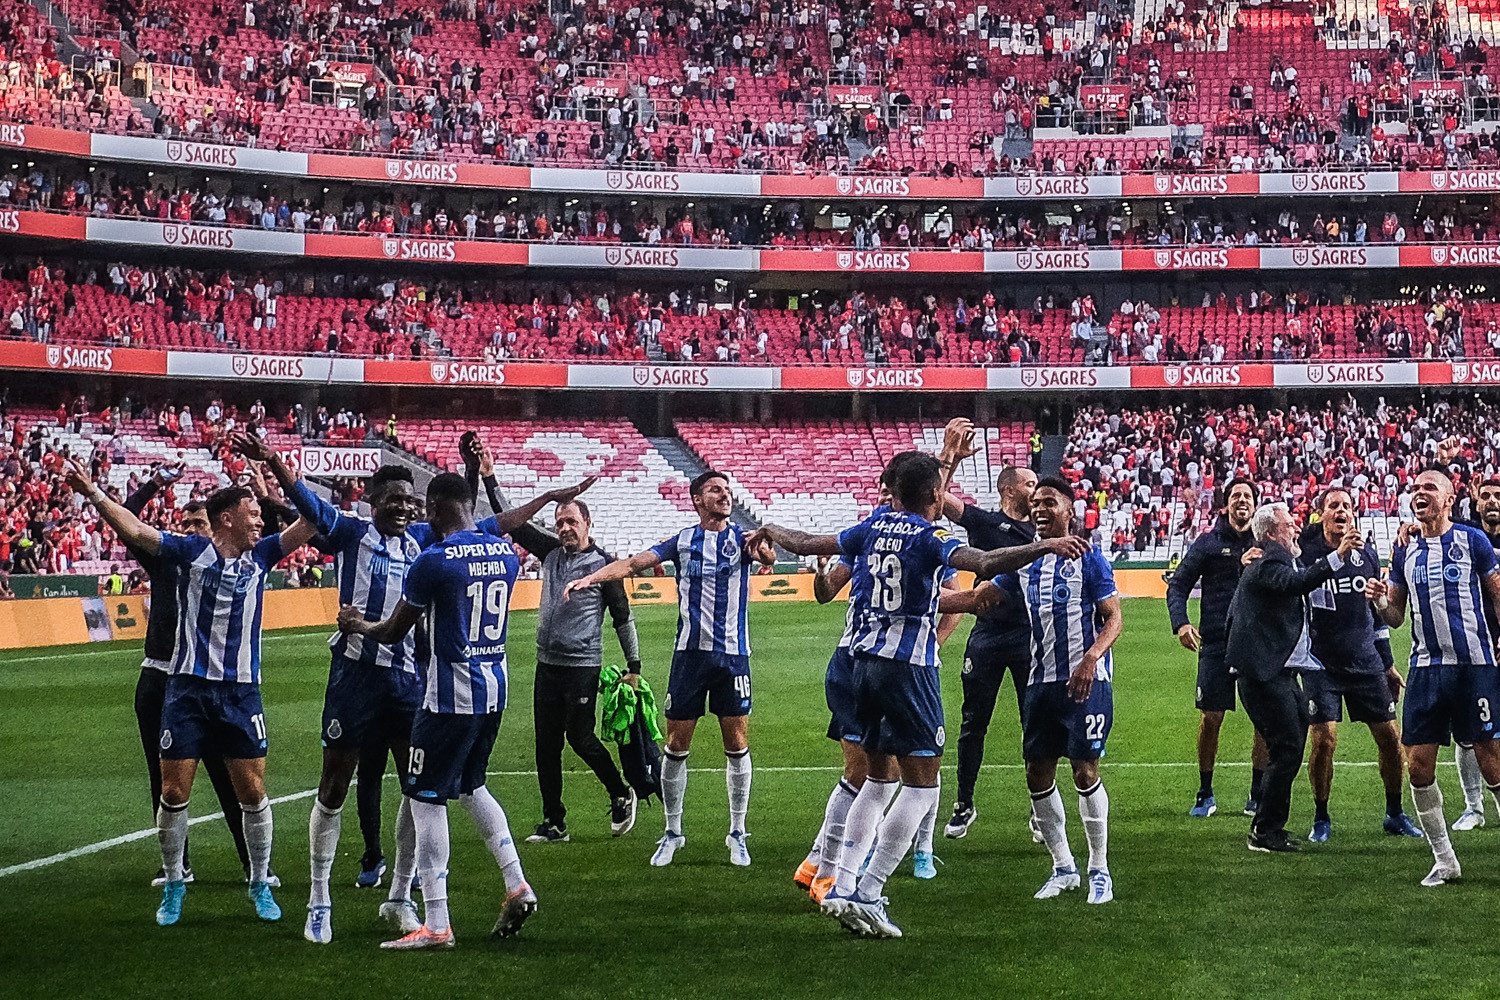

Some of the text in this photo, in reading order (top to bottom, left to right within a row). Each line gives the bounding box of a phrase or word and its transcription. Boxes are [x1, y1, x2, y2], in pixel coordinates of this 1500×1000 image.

[846, 94, 872, 104] SAGRES
[0, 124, 26, 146] RES
[185, 144, 237, 166] SAGRES
[404, 159, 457, 182] SAGRES
[625, 171, 680, 191] SAGRES
[854, 176, 909, 195] SAGRES
[1035, 176, 1089, 195] SAGRES
[1173, 174, 1228, 194] SAGRES
[1311, 173, 1366, 190] SAGRES
[181, 227, 234, 248] SAGRES
[401, 238, 456, 262] SAGRES
[624, 248, 678, 267] SAGRES
[1173, 250, 1228, 268] SAGRES
[1312, 248, 1367, 266] SAGRES
[854, 252, 910, 270] SAGRES
[1035, 252, 1090, 270] SAGRES
[62, 345, 113, 370] SAGRES
[250, 355, 304, 378] SAGRES
[450, 361, 505, 384] SAGRES
[652, 367, 709, 386] SAGRES
[866, 368, 924, 388] SAGRES
[1040, 368, 1097, 388] SAGRES
[1182, 365, 1241, 386] SAGRES
[1327, 363, 1384, 383] SAGRES
[324, 452, 379, 472] SAGRES
[444, 544, 484, 560] SUPER
[468, 560, 506, 576] MBEMBA
[1412, 563, 1462, 584] MEO
[868, 553, 903, 612] 13
[1027, 584, 1072, 604] MEO
[467, 580, 508, 642] 19
[472, 644, 506, 656] BINANCE
[735, 674, 751, 699] 46
[1478, 698, 1490, 722] 3
[250, 713, 267, 740] 11
[1086, 714, 1106, 740] 22
[408, 747, 425, 775] 19
